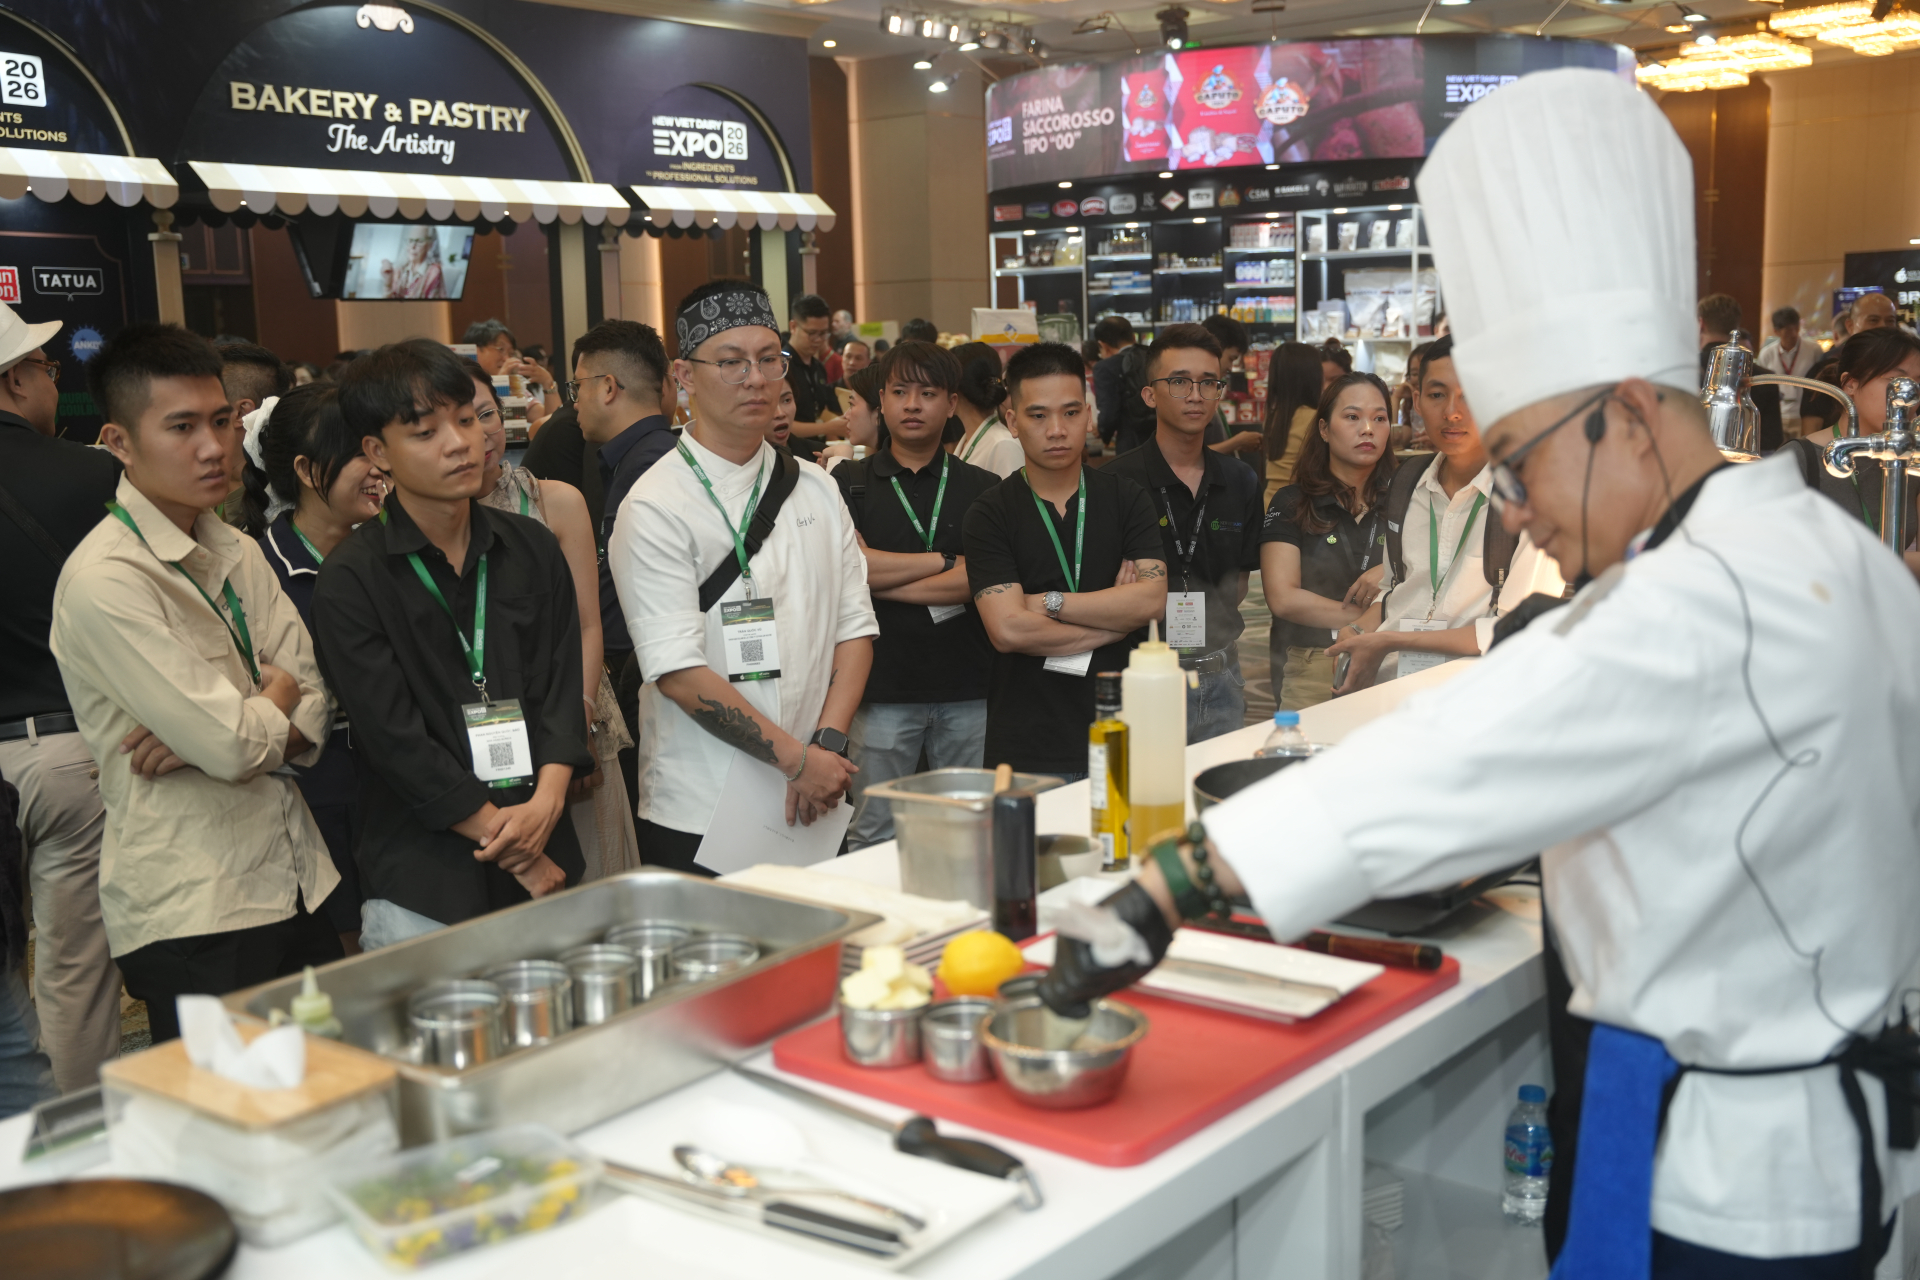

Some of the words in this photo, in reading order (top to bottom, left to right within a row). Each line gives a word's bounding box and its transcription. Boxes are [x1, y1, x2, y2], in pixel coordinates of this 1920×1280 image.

[5, 59, 37, 79] 20
[7, 80, 39, 100] 26
[229, 81, 378, 120] BAKERY
[383, 102, 402, 123] &
[408, 98, 531, 133] PASTRY
[1021, 95, 1065, 119] FARINA
[652, 115, 675, 128] NEW
[674, 116, 696, 129] VIET
[695, 118, 723, 131] DAIRY
[1022, 107, 1115, 137] SACCOROSSO
[727, 127, 743, 139] 20
[326, 123, 368, 152] The
[370, 125, 456, 165] Artistry
[652, 128, 724, 160] EXPO
[728, 142, 744, 155] 26
[1023, 136, 1049, 156] TIPO
[682, 161, 736, 173] INGREDIENTS
[652, 171, 714, 183] PROFESSIONAL
[714, 174, 758, 186] SOLUTIONS
[1249, 188, 1270, 200] CSM
[39, 273, 97, 288] TATUA
